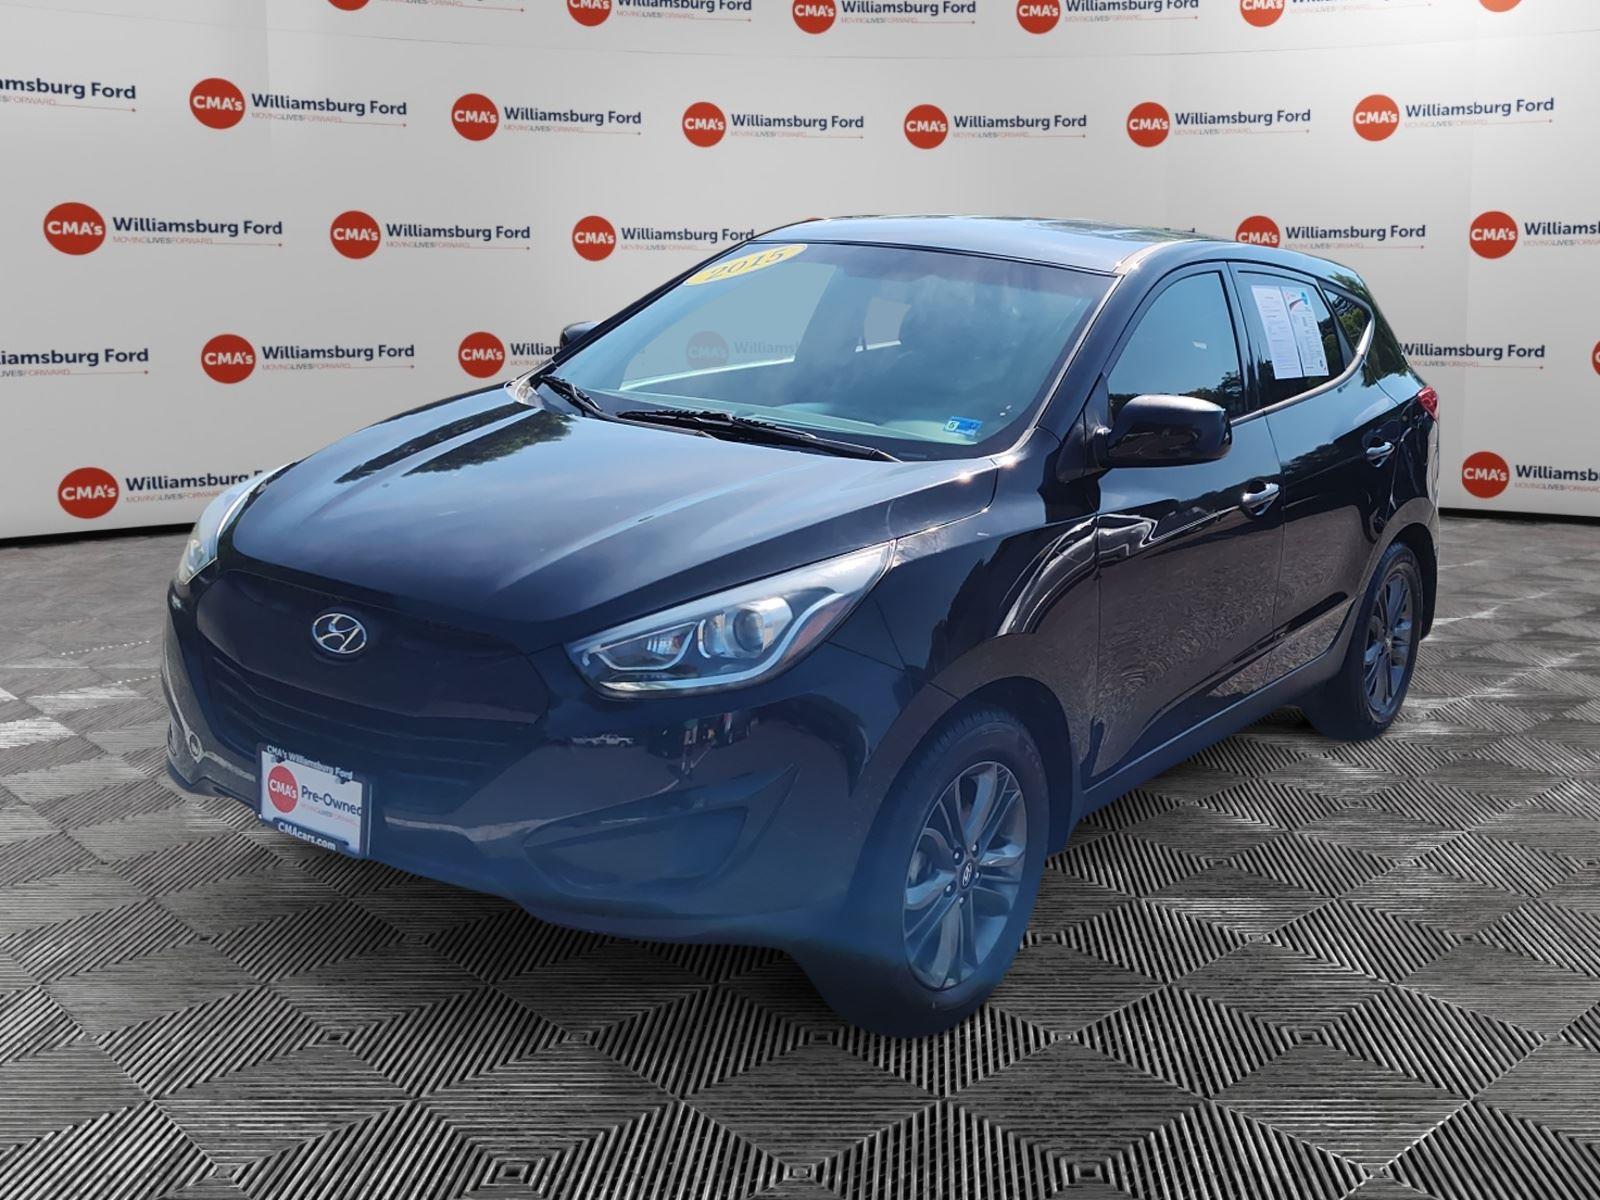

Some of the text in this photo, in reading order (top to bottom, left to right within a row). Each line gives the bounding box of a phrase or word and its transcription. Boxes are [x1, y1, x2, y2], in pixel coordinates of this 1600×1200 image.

[719, 0, 752, 11] Ford
[794, 1, 976, 17] CMA's Williamsburg Ford
[1018, 0, 1199, 17] CMA's Williamsburg Ford
[91, 82, 136, 99] Ford
[192, 93, 407, 117] CMA's Williamsburg Ford
[1355, 98, 1554, 124] CMA's Williamsburg Ford
[454, 107, 641, 126] CMA's Williamsburg Ford
[684, 114, 864, 131] CMA's Williamsburg Ford
[906, 115, 1087, 132] CMA's Williamsburg Ford
[1129, 109, 1311, 131] CMA's Williamsburg Ford
[47, 217, 283, 237] CMA's Williamsburg Ford
[333, 224, 530, 241] CMA's Williamsburg Ford
[575, 227, 755, 244] CMA's Williamsburg Ford
[1238, 225, 1426, 244] CMA's Williamsburg Ford
[1471, 228, 1516, 241] CMA's
[708, 251, 784, 280] 2015
[0, 348, 148, 366] iamsburg Ford
[204, 344, 414, 366] CMA's Williamsburg Ford
[461, 348, 503, 361] CMA's
[1400, 343, 1545, 360] Williamsburg Ford
[1464, 465, 1600, 481] CMA's Williamsb
[61, 484, 117, 500] CMA's
[267, 745, 287, 760] CMA's
[335, 767, 353, 779] Ford
[269, 778, 298, 799] CMA's
[278, 822, 337, 851] CMAcars.com
